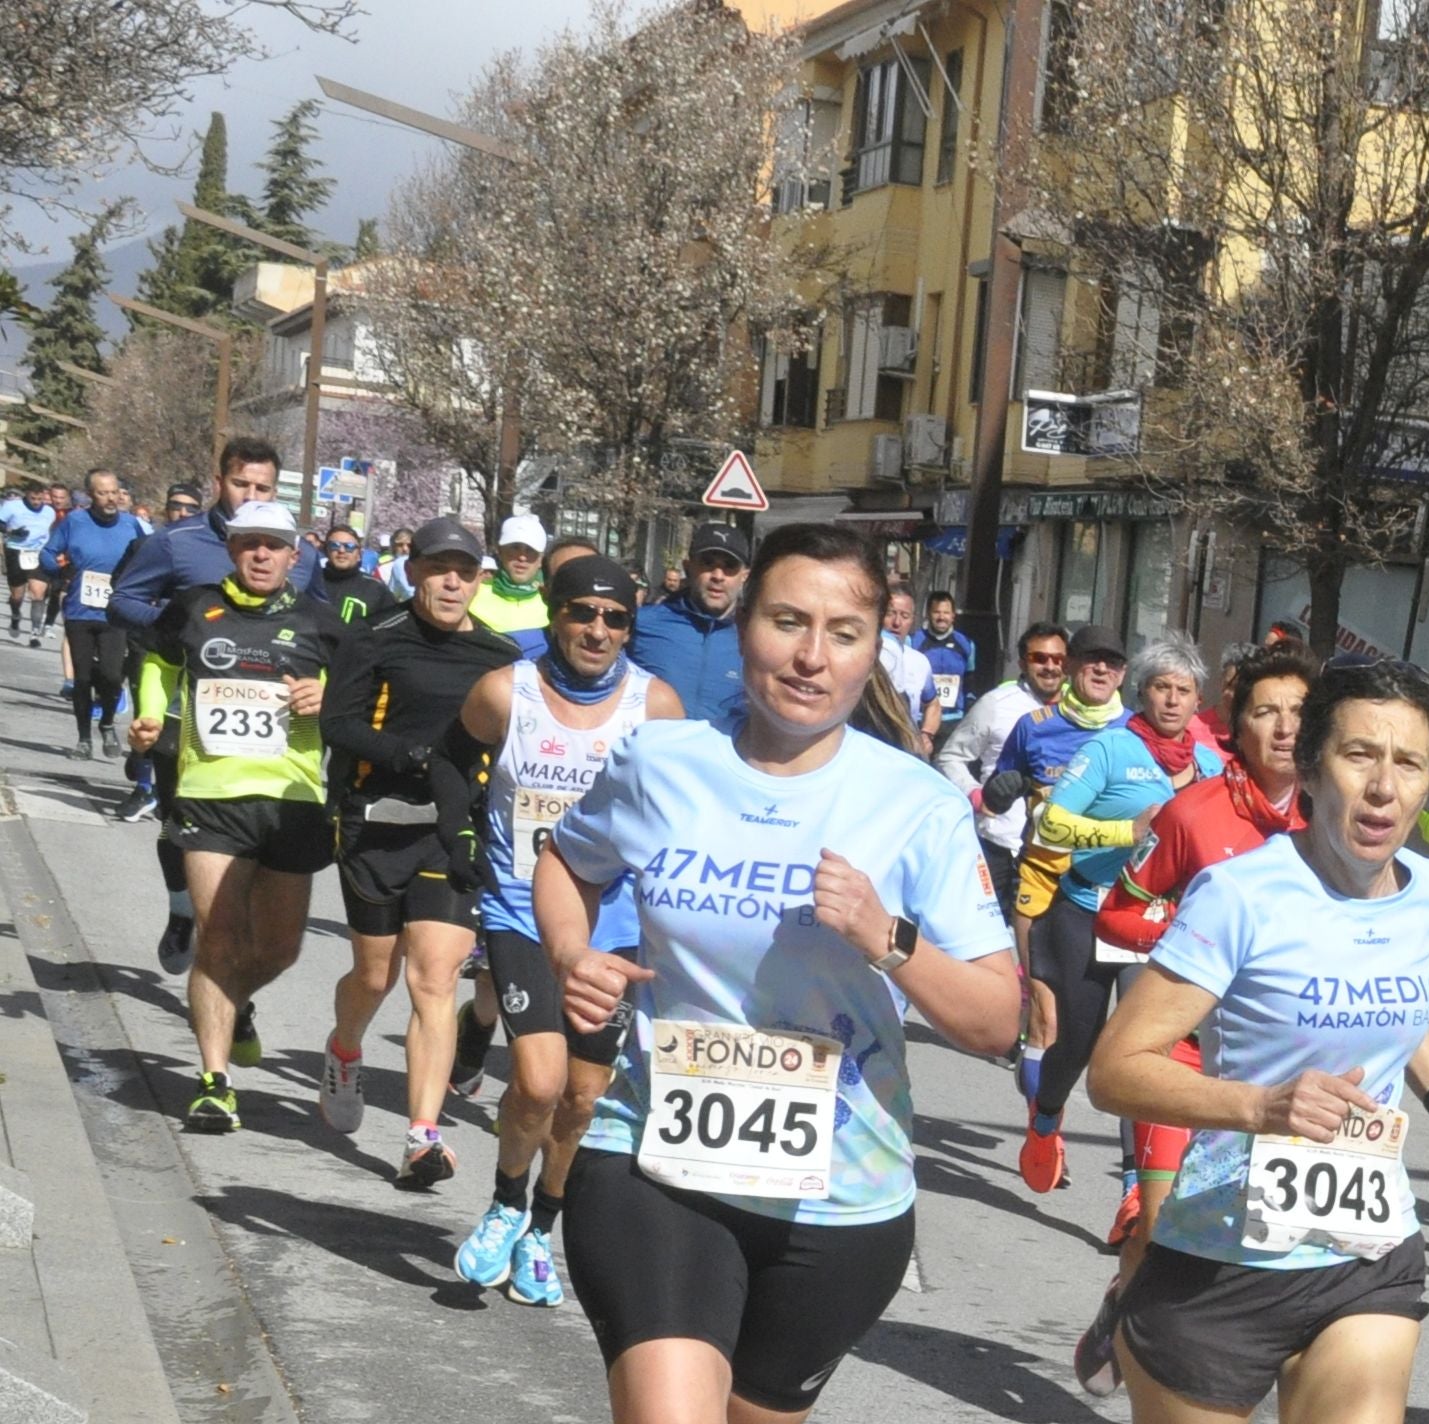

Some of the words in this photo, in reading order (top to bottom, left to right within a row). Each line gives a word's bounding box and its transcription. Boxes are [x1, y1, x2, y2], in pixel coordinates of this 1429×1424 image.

[209, 707, 273, 738] 233
[638, 886, 784, 922] MARATÓN
[797, 905, 821, 928] B
[1297, 1007, 1406, 1029] MARATÓN
[692, 1038, 802, 1072] FONDO
[658, 1089, 818, 1157] 3045
[1263, 1157, 1390, 1224] 3043
